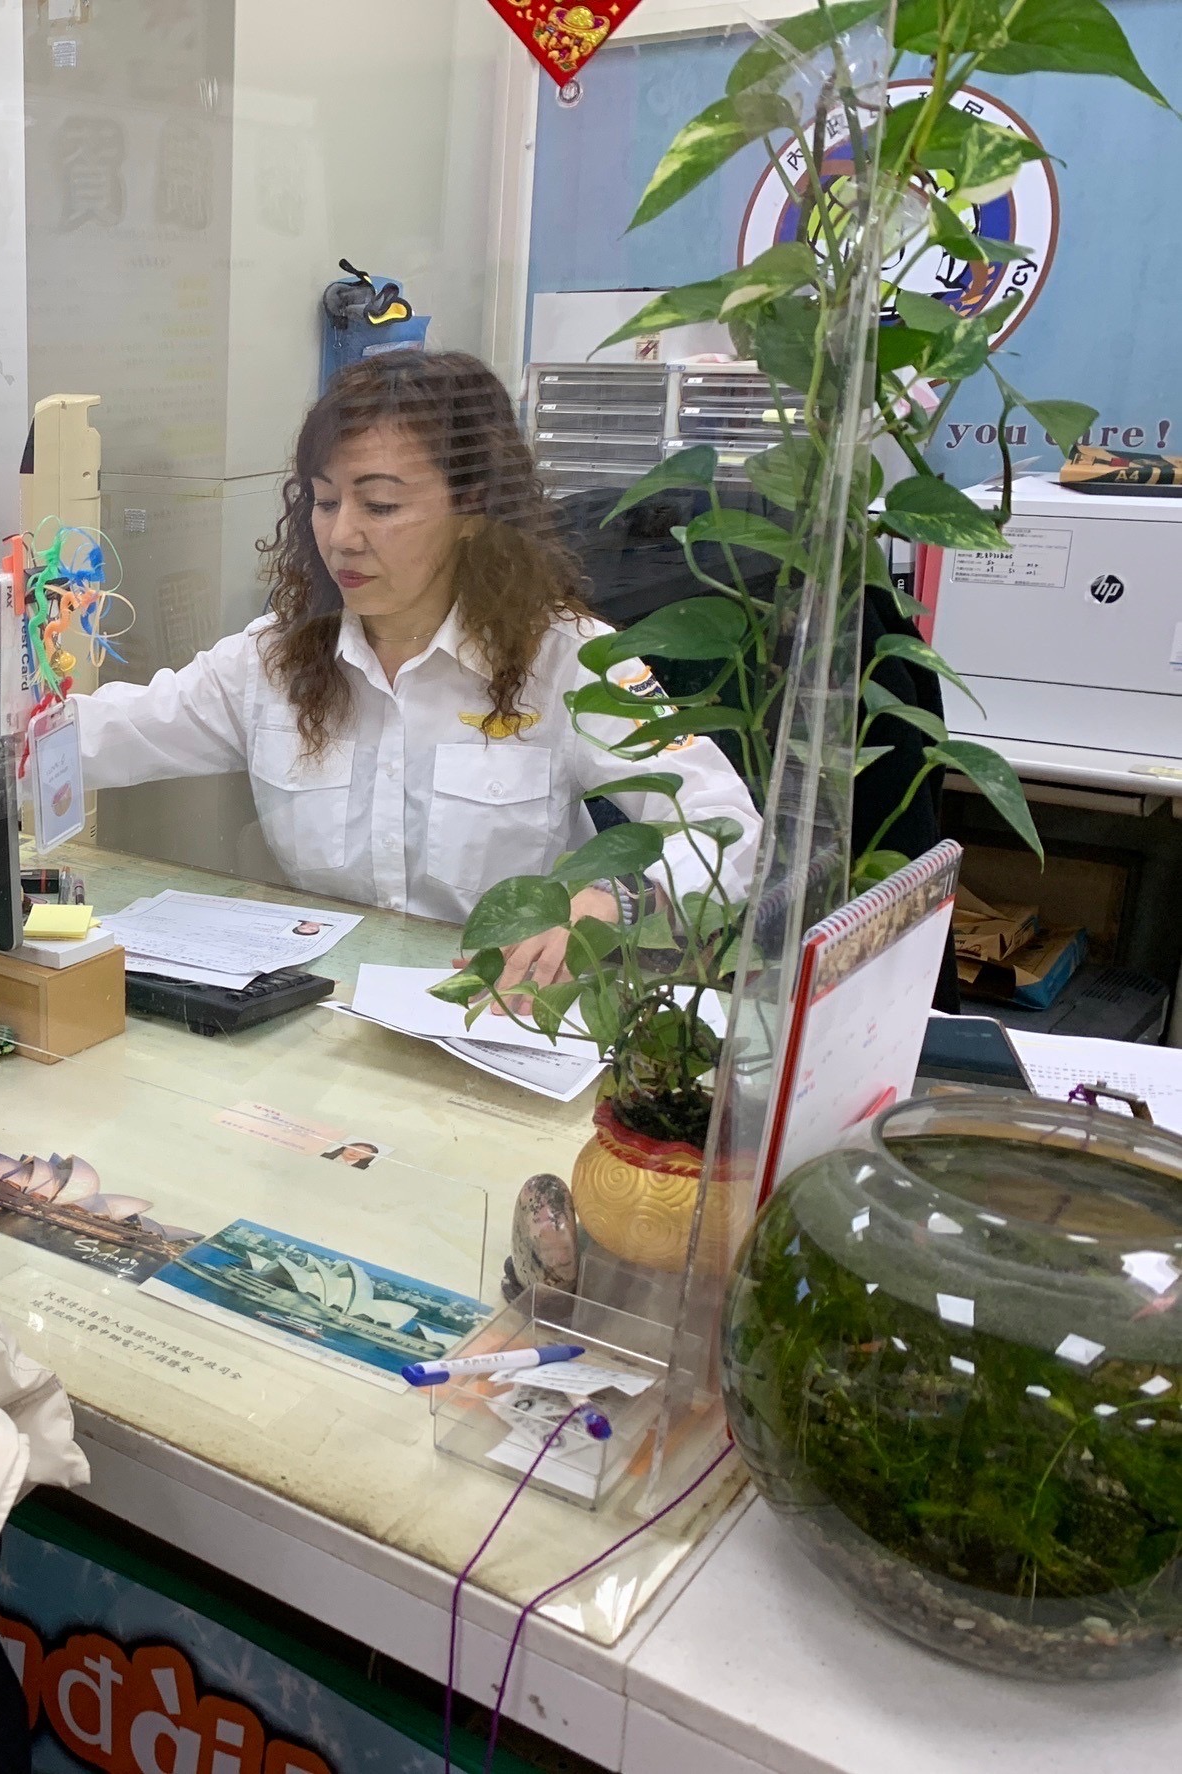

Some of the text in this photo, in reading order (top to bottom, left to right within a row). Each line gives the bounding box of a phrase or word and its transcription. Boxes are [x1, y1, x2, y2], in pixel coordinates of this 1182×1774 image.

[946, 422, 1027, 448] you
[1115, 470, 1139, 483] A4
[1093, 575, 1122, 604] hp
[20, 652, 29, 691] Card
[73, 1240, 139, 1278] Sydney
